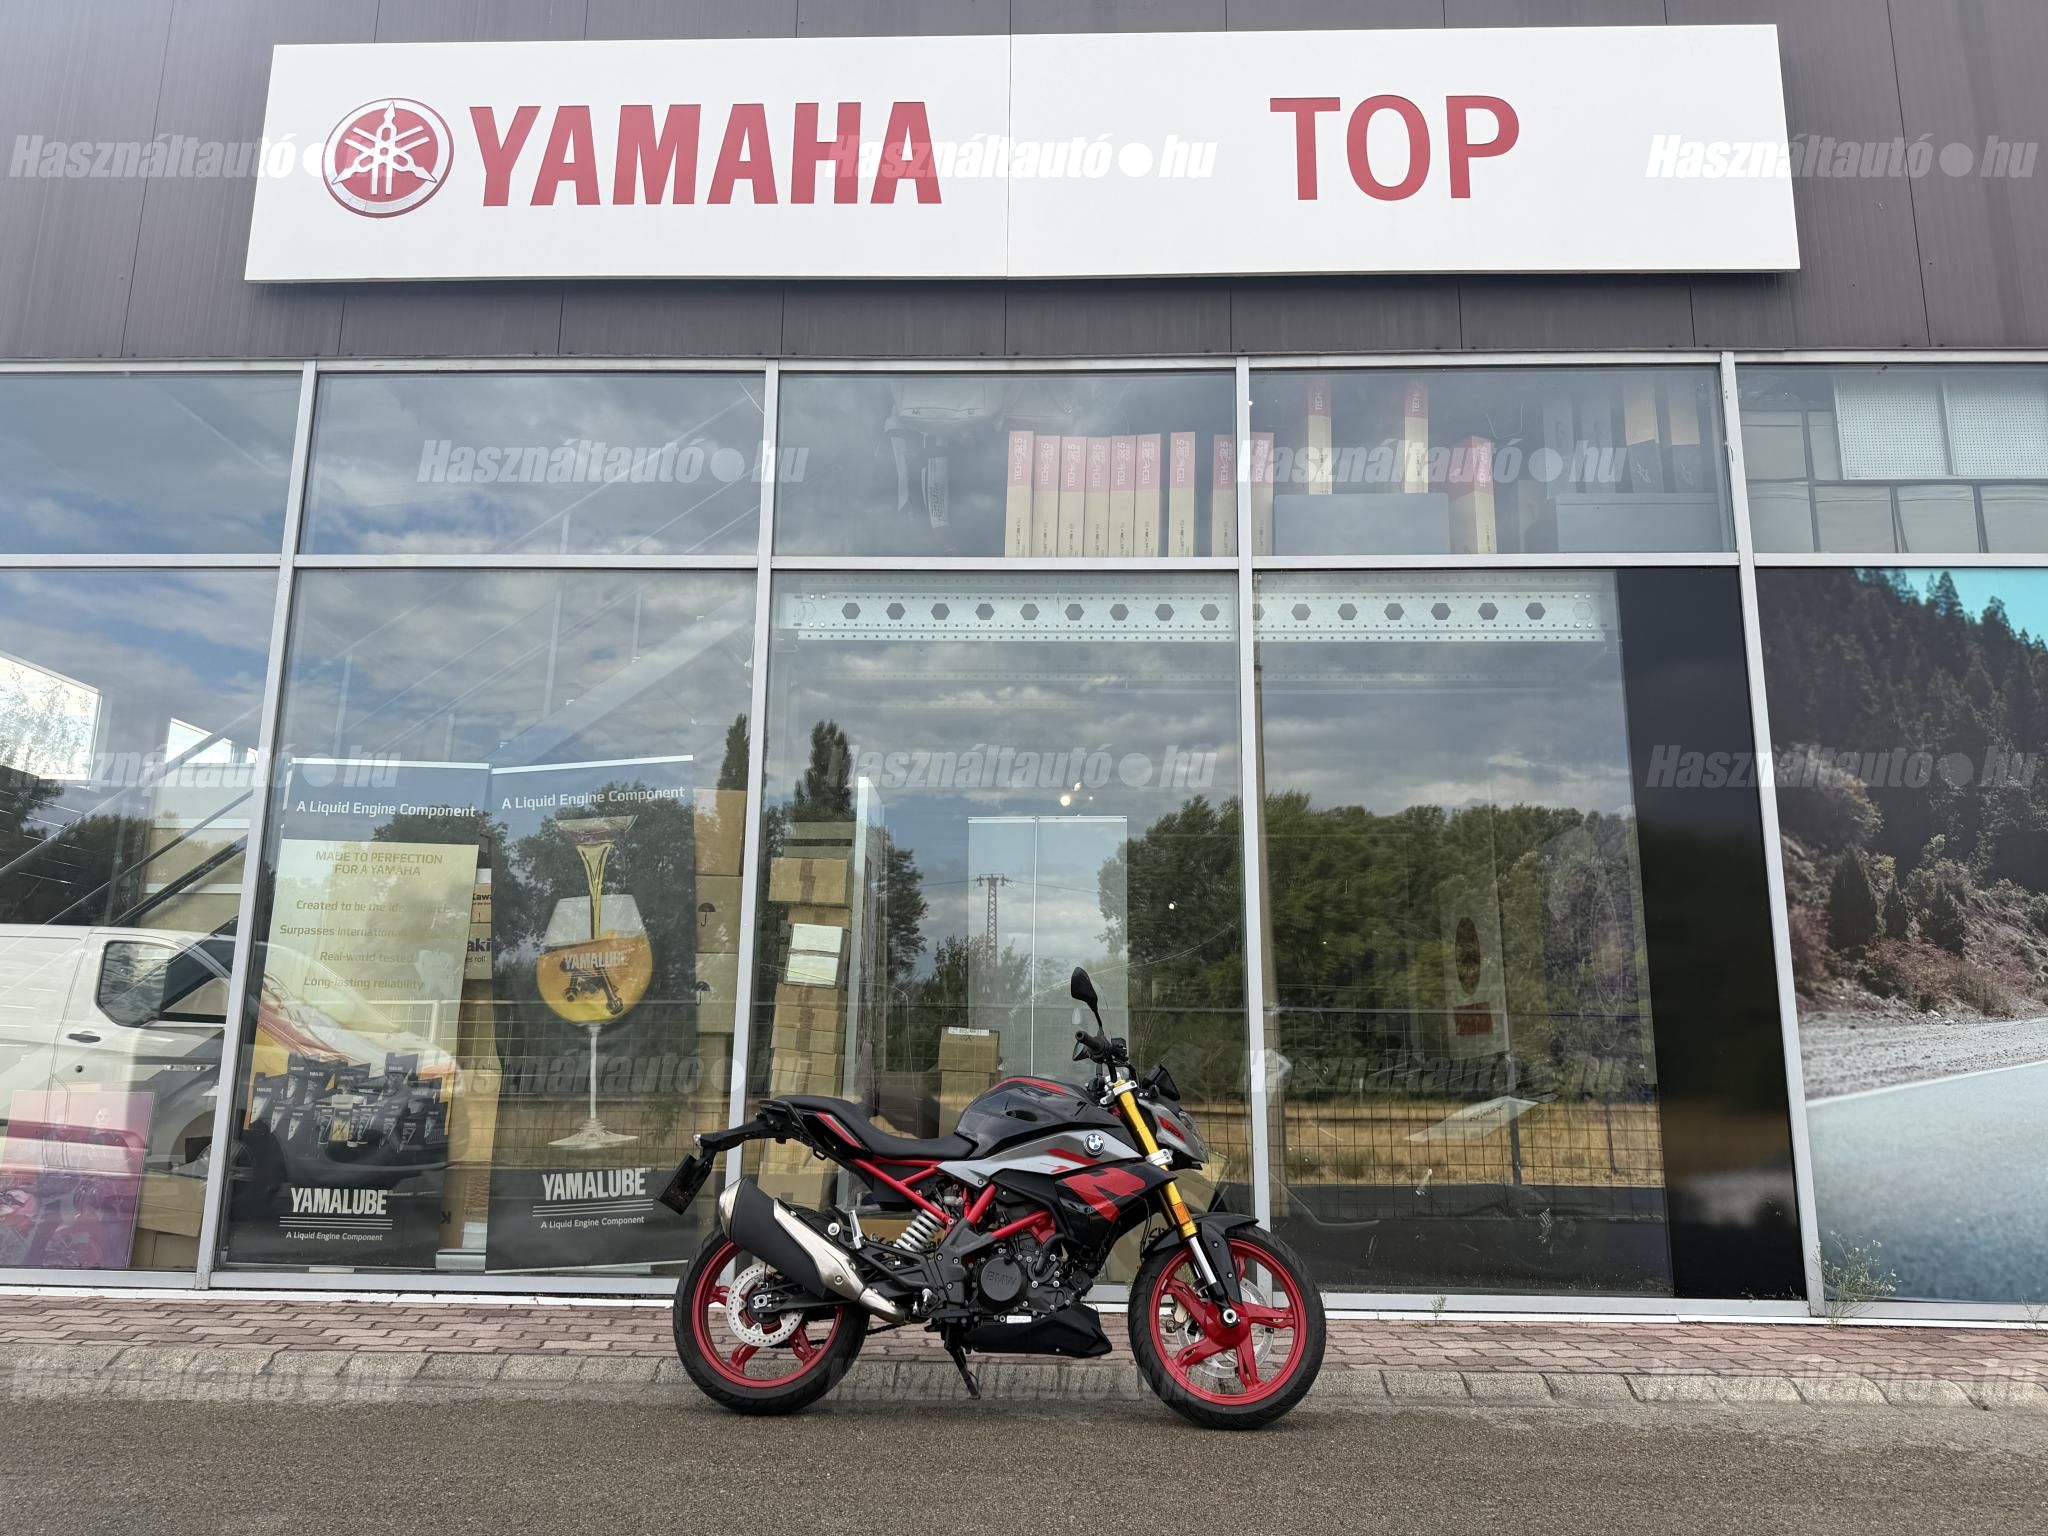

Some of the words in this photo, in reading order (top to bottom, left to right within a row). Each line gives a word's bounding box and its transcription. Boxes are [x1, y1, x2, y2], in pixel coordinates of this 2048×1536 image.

[469, 101, 942, 207] YAMAHA
[1270, 94, 1520, 201] TOP
[502, 798, 512, 810] A
[515, 795, 556, 811] Liquid
[559, 792, 605, 807] Engine
[608, 786, 686, 803] Component
[296, 801, 306, 812] A
[309, 801, 350, 816] Liquid
[353, 802, 396, 817] Engine
[400, 803, 477, 818] Component
[315, 850, 351, 862] MADE
[355, 851, 369, 862] TO
[371, 853, 443, 864] PERFECTION
[335, 865, 358, 874] FOR
[360, 865, 368, 874] A
[370, 866, 421, 876] YAMAHA
[296, 900, 338, 911] Created
[340, 901, 352, 911] to
[354, 901, 367, 912] be
[280, 924, 335, 936] Surpasses
[338, 927, 407, 938] internation
[320, 951, 376, 962] Real-world
[565, 951, 625, 969] YAMALUBE
[303, 977, 370, 989] Long-lasting
[374, 978, 425, 990] reliability
[541, 1168, 646, 1201] YAMALUBE
[290, 1187, 388, 1215] YAMALUBE
[540, 1221, 547, 1229] A
[549, 1219, 573, 1230] Liquid
[574, 1218, 599, 1229] Engine
[601, 1216, 644, 1227] Component
[286, 1231, 292, 1239] A
[294, 1231, 315, 1241] Liquid
[317, 1232, 341, 1242] Engine
[342, 1233, 384, 1242] Component
[986, 1271, 1018, 1289] BMW
